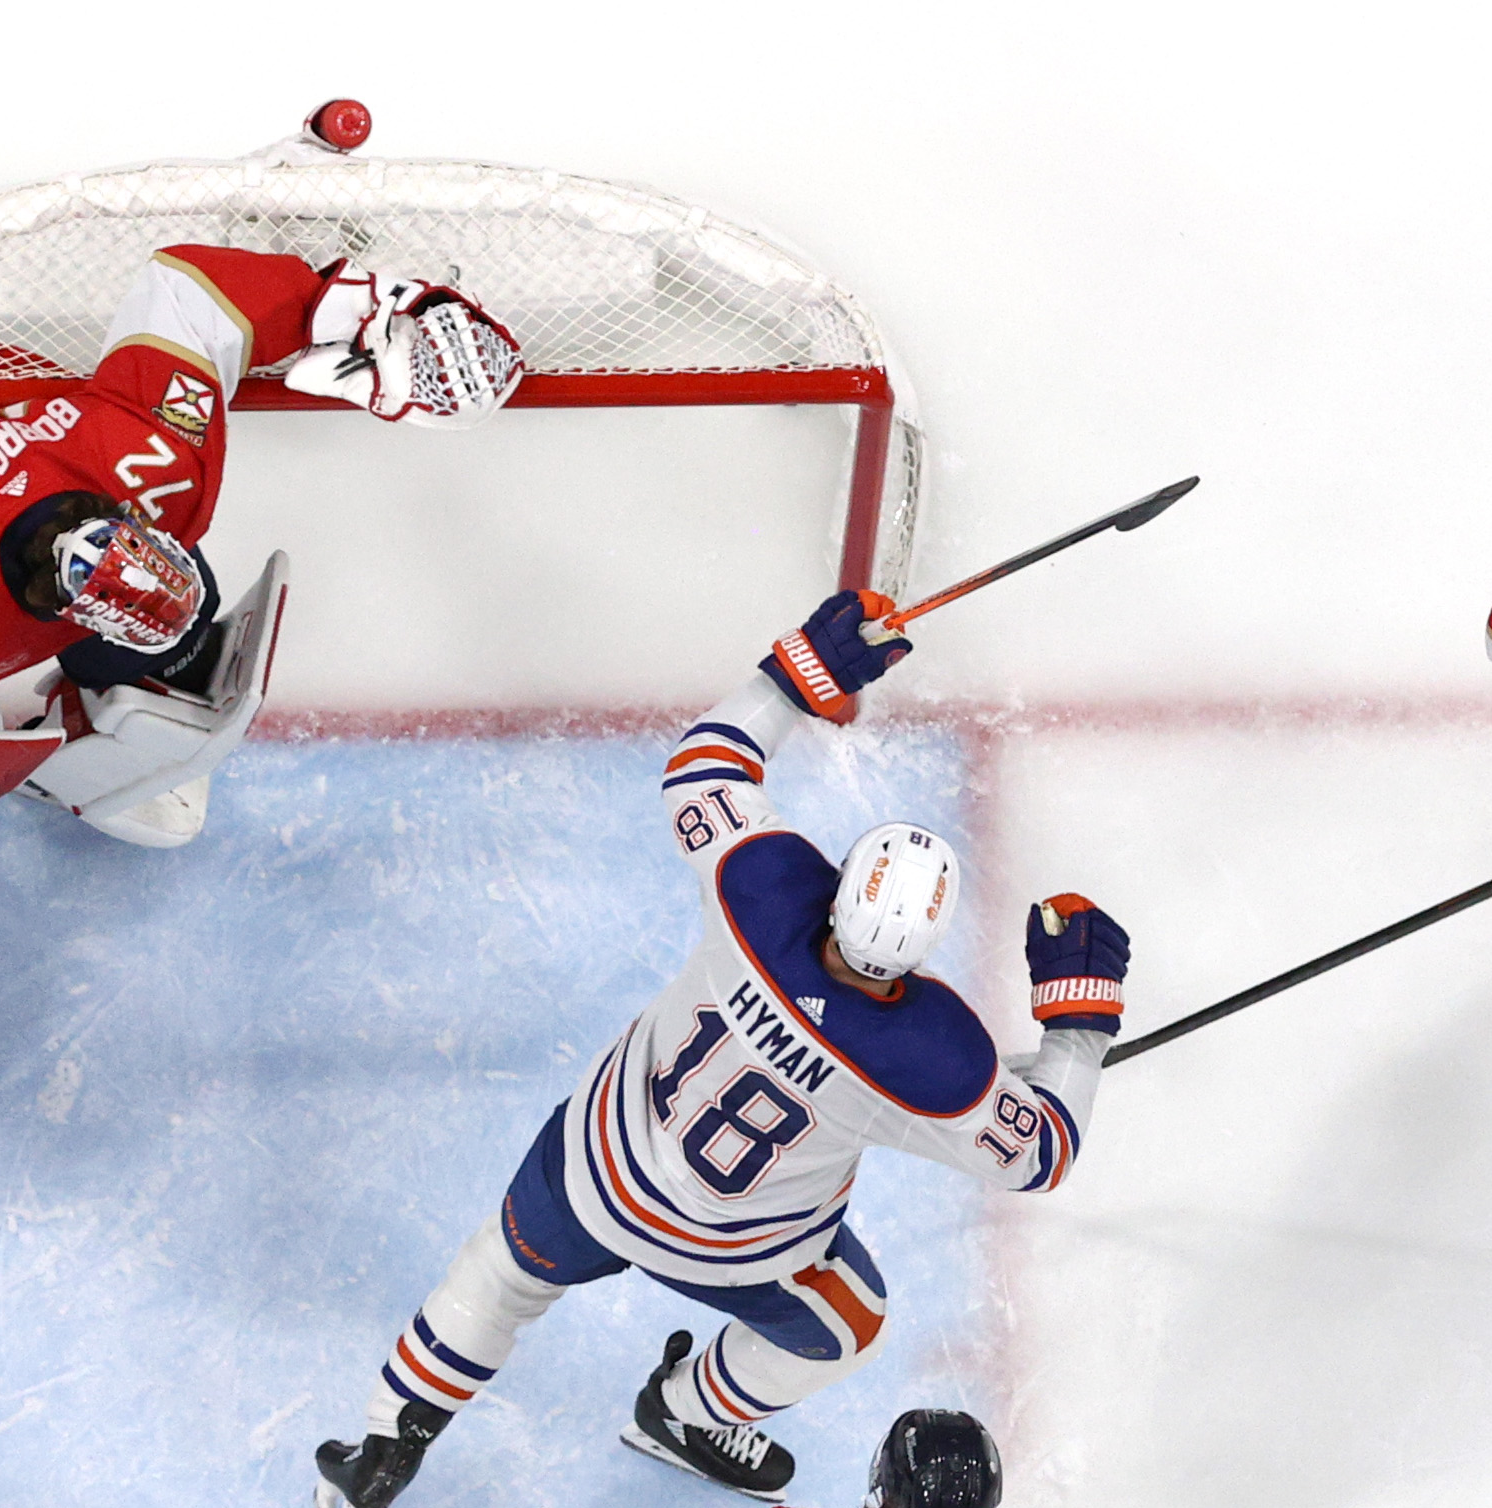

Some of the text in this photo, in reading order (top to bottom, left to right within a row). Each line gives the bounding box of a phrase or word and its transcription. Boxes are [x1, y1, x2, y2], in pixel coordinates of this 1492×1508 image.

[114, 433, 194, 521] 72
[674, 783, 750, 855] 18
[909, 831, 933, 850] 18
[728, 980, 837, 1093] HYMAN
[648, 1004, 817, 1201] 18
[975, 1087, 1044, 1169] 18
